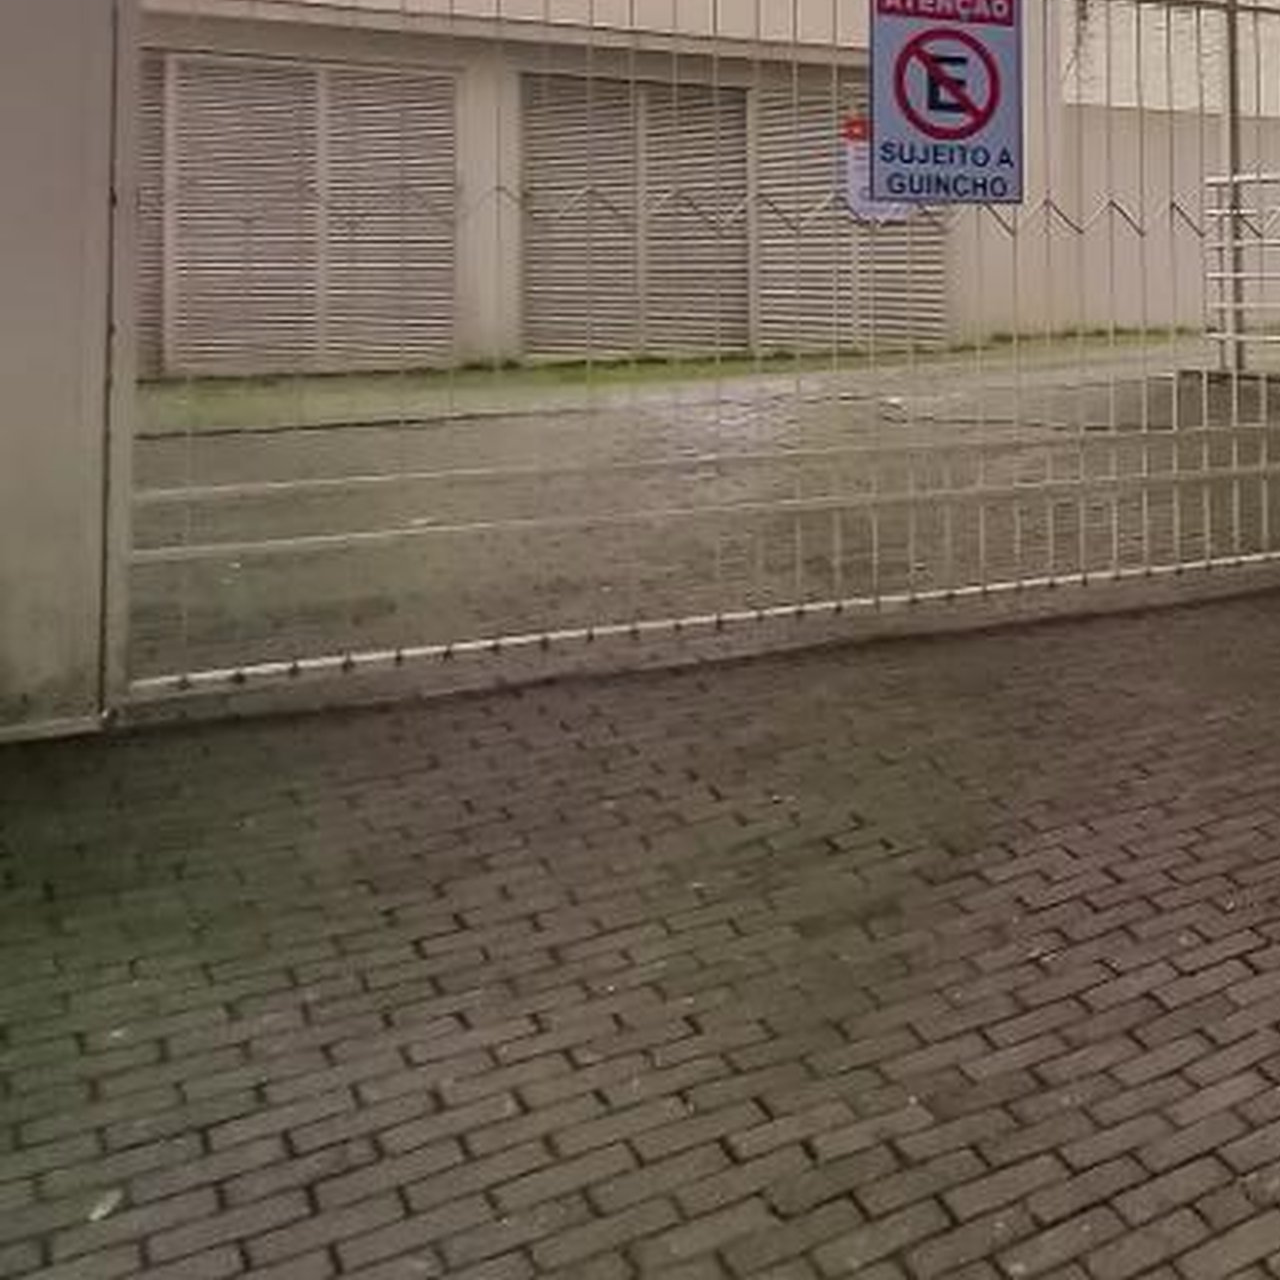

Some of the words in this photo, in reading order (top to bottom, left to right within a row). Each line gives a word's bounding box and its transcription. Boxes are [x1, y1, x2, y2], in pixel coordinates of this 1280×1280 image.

[880, 142, 990, 167] SUJEITO
[997, 147, 1014, 168] A
[886, 173, 1007, 197] GUINCHO
